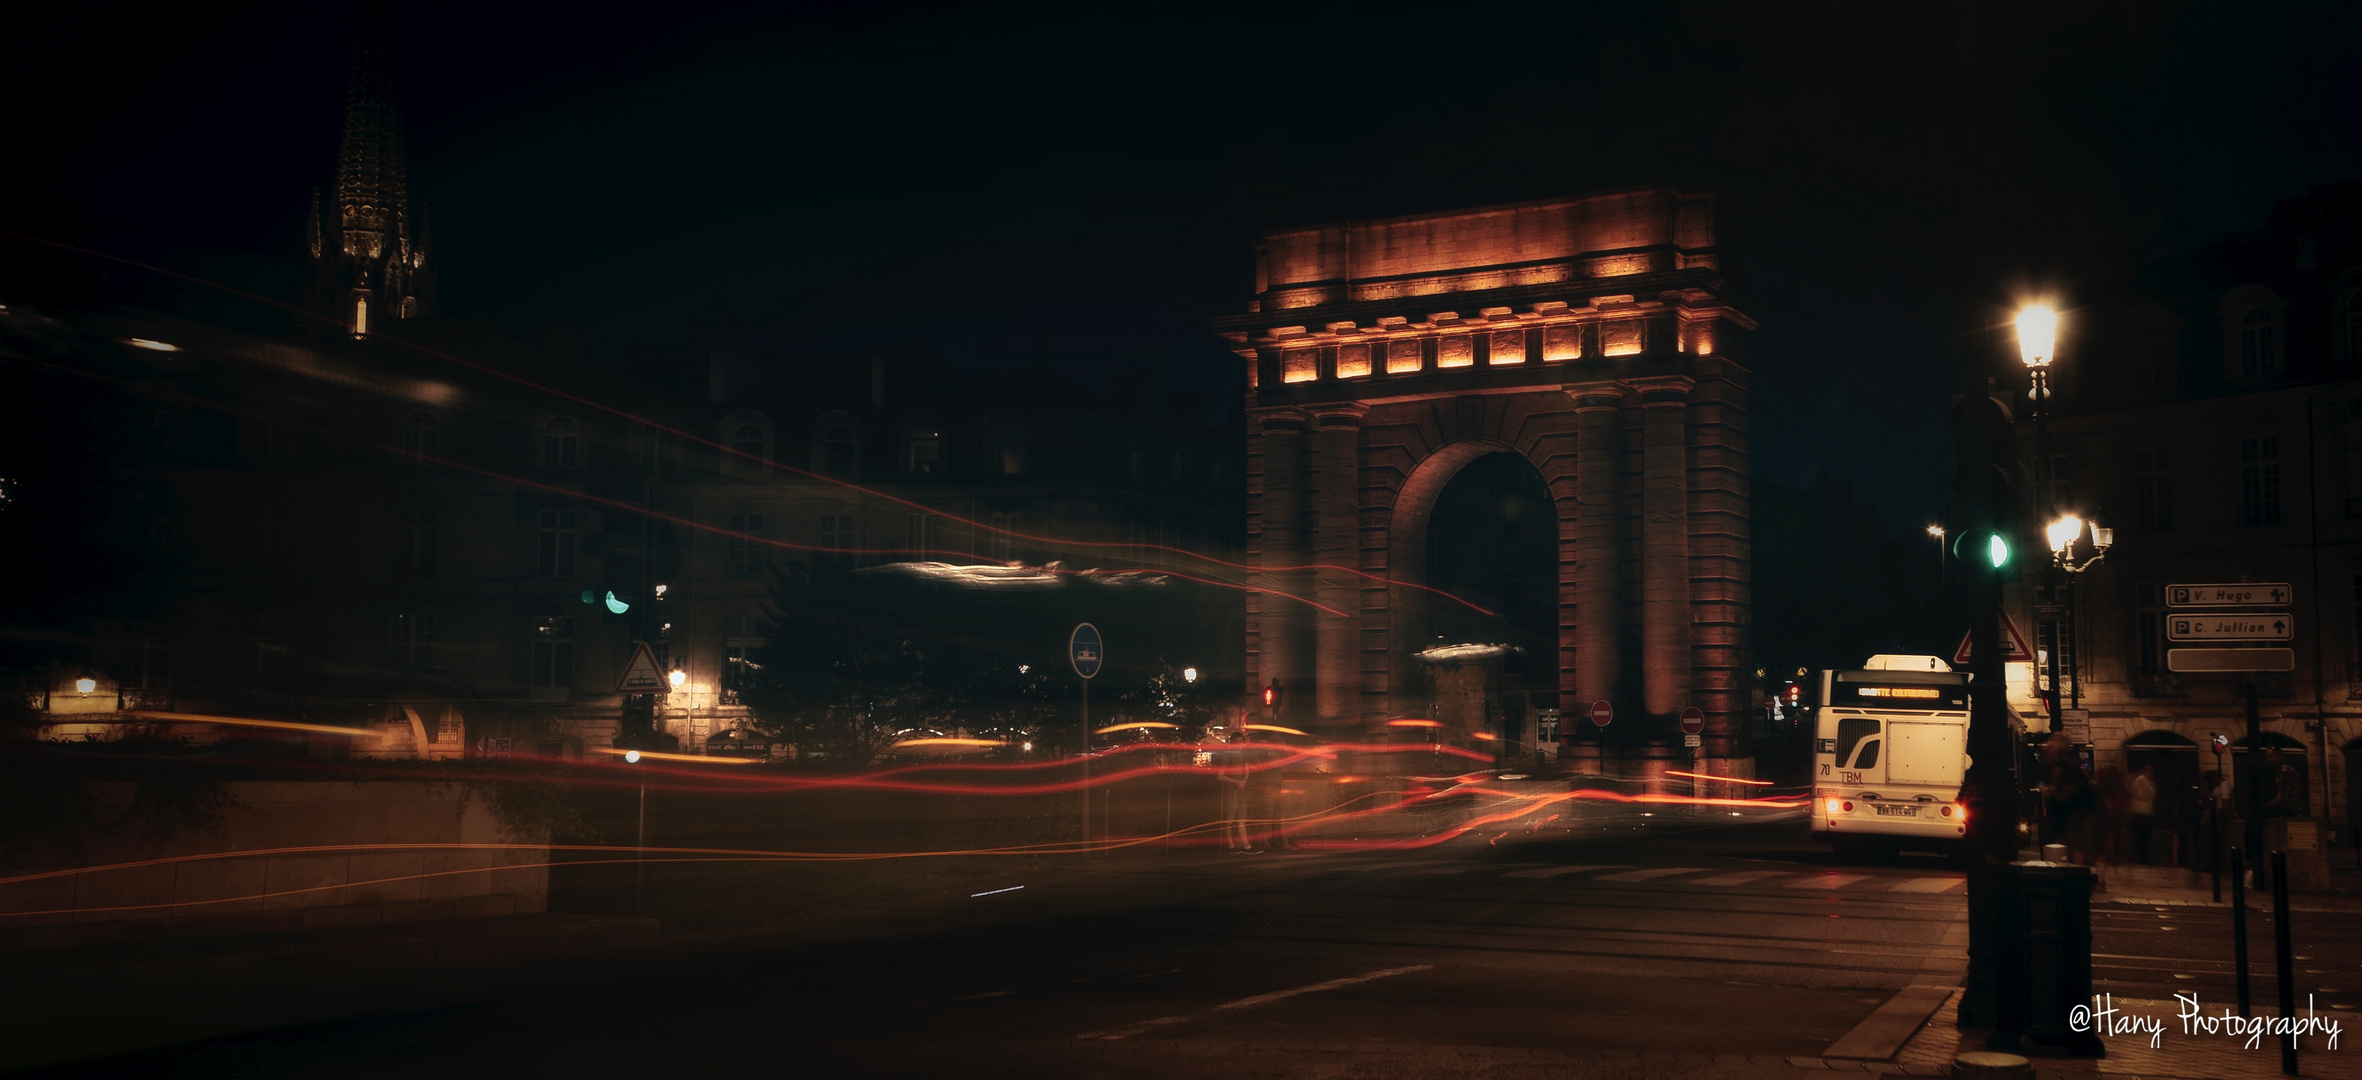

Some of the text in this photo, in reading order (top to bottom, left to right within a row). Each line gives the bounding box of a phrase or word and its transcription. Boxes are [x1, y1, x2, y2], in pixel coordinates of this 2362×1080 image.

[2176, 590, 2252, 603] P V. Hugo
[2177, 621, 2265, 633] P C. Jullian
[1820, 763, 1831, 776] 70
[1839, 771, 1863, 785] TBM
